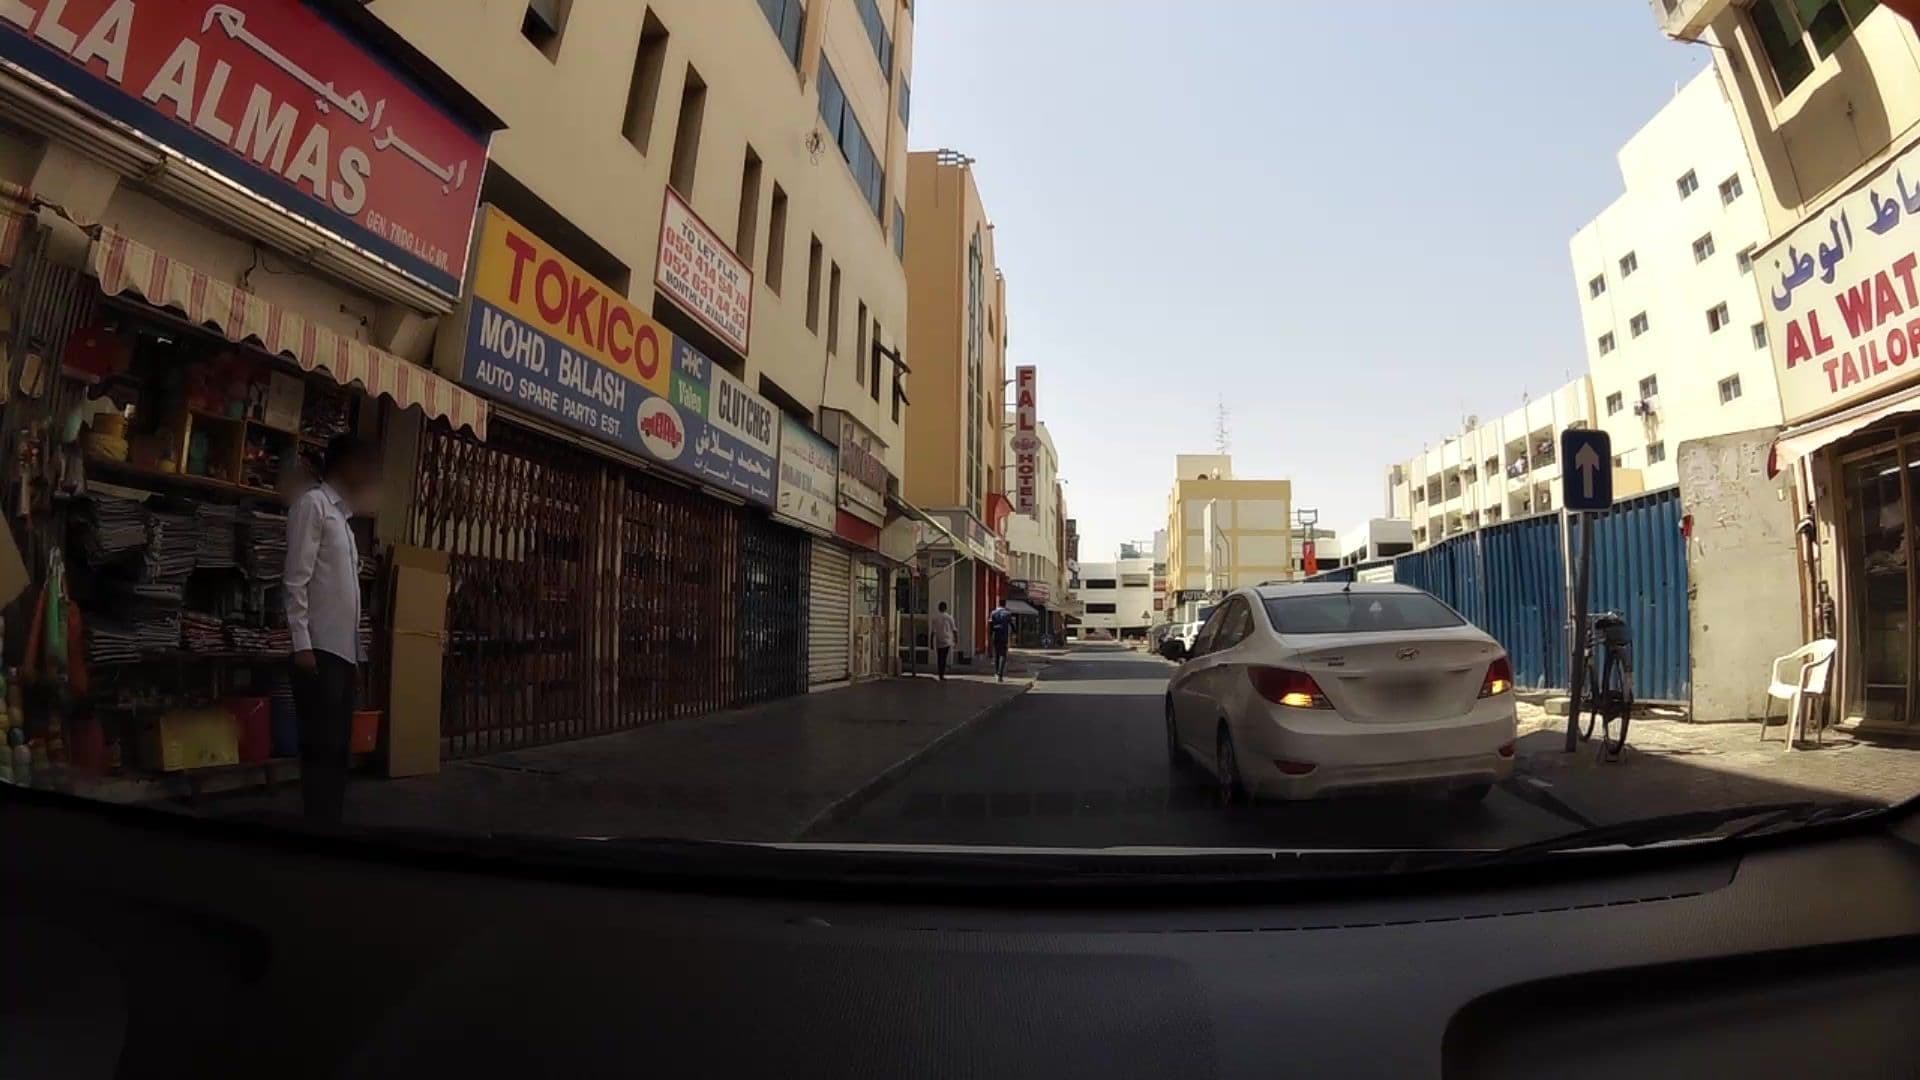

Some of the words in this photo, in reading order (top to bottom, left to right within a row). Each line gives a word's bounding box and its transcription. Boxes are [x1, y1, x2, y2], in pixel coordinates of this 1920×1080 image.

[142, 37, 371, 216] ALMAS
[366, 209, 388, 238] GEN.
[665, 226, 693, 263] 055
[681, 221, 696, 244] TO
[697, 237, 716, 264] LET
[717, 257, 739, 286] FLAT
[663, 247, 690, 284] 052
[1771, 206, 1853, 312] الوطن
[505, 231, 660, 380] TOKICO
[665, 269, 705, 312] MONTHLY
[704, 303, 742, 342] AVAILABLE
[1786, 309, 1834, 370] AL
[1835, 252, 1920, 339] WAT
[480, 307, 549, 377] MOHD.
[557, 347, 626, 412] BALASH
[476, 360, 515, 393] AUTO
[518, 378, 559, 413] SPARE
[562, 400, 598, 428] PARTS
[600, 415, 623, 439] EST.
[718, 378, 772, 446] CLUTCHES
[1018, 369, 1034, 431] FAL
[1018, 454, 1034, 512] HOTEL
